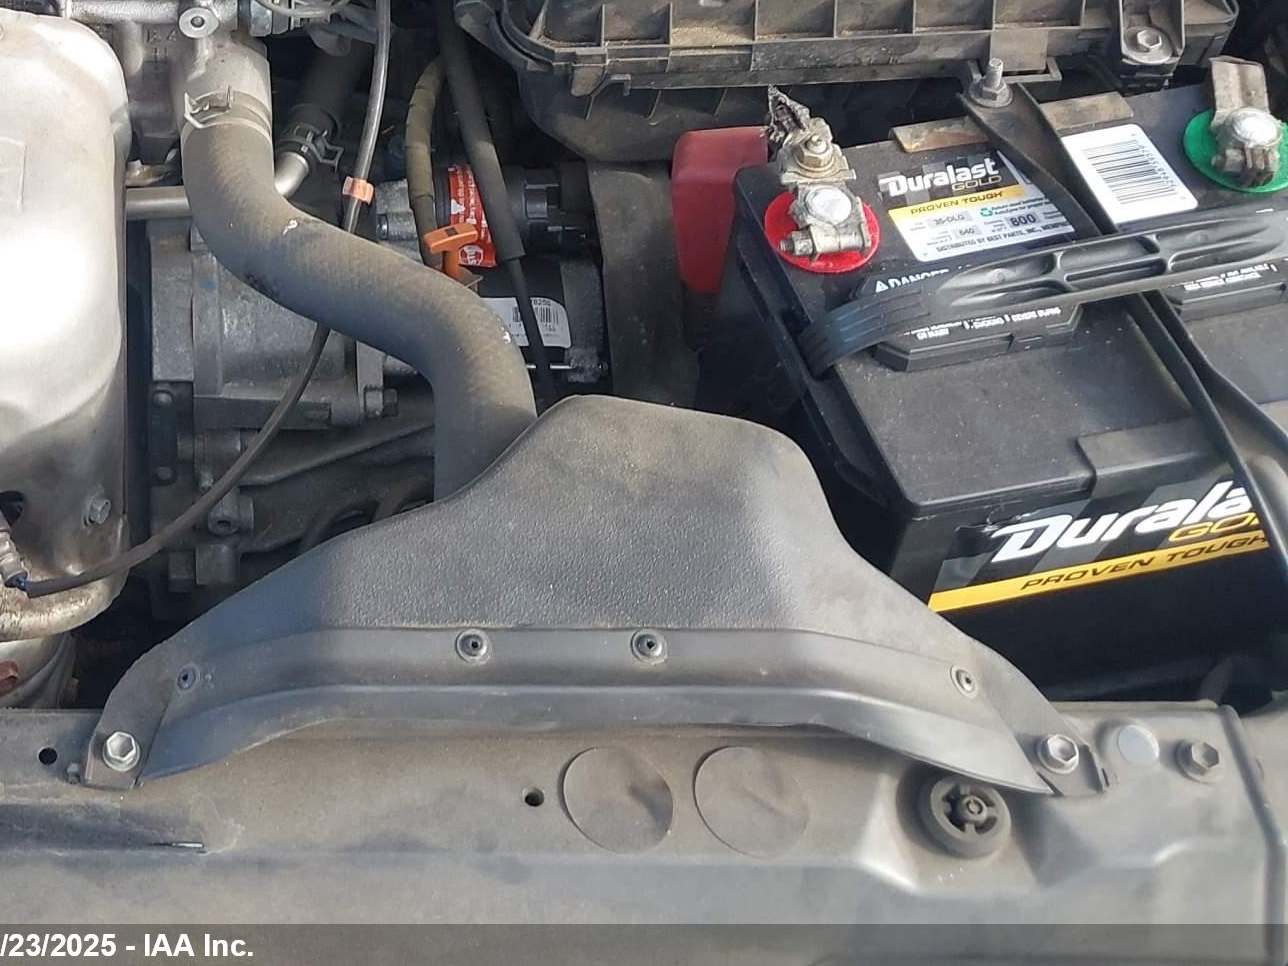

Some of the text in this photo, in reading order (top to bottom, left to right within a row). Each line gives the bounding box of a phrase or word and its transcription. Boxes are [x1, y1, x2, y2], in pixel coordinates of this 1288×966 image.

[878, 157, 1000, 198] Duralast
[951, 174, 1003, 192] GOLD
[910, 190, 1004, 215] PROVEN TOUGH
[1009, 213, 1037, 227] 800
[1020, 556, 1154, 591] PROVEN
